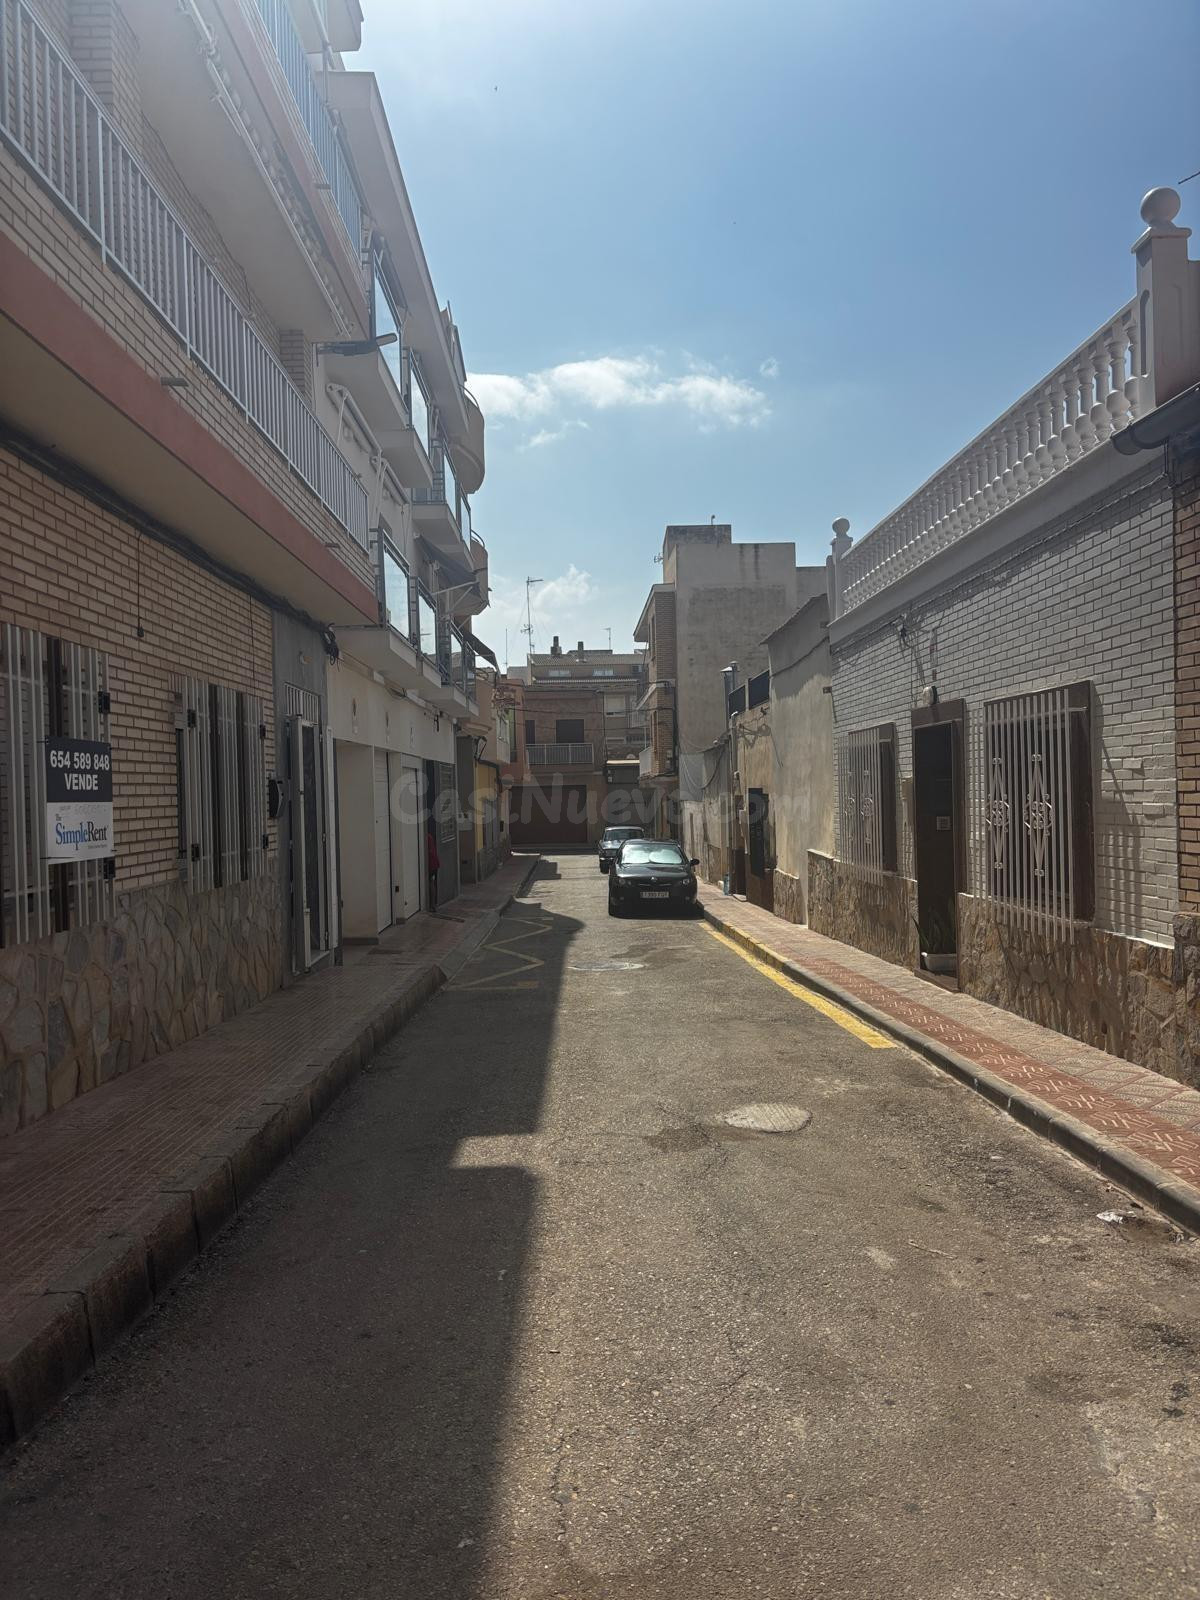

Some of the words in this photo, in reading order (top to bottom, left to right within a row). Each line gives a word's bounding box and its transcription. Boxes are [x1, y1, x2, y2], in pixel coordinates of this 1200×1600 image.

[50, 750, 71, 769] 654
[73, 752, 91, 770] 589
[93, 753, 110, 771] 848
[64, 773, 98, 790] VENDE
[55, 821, 107, 850] SimpleRent
